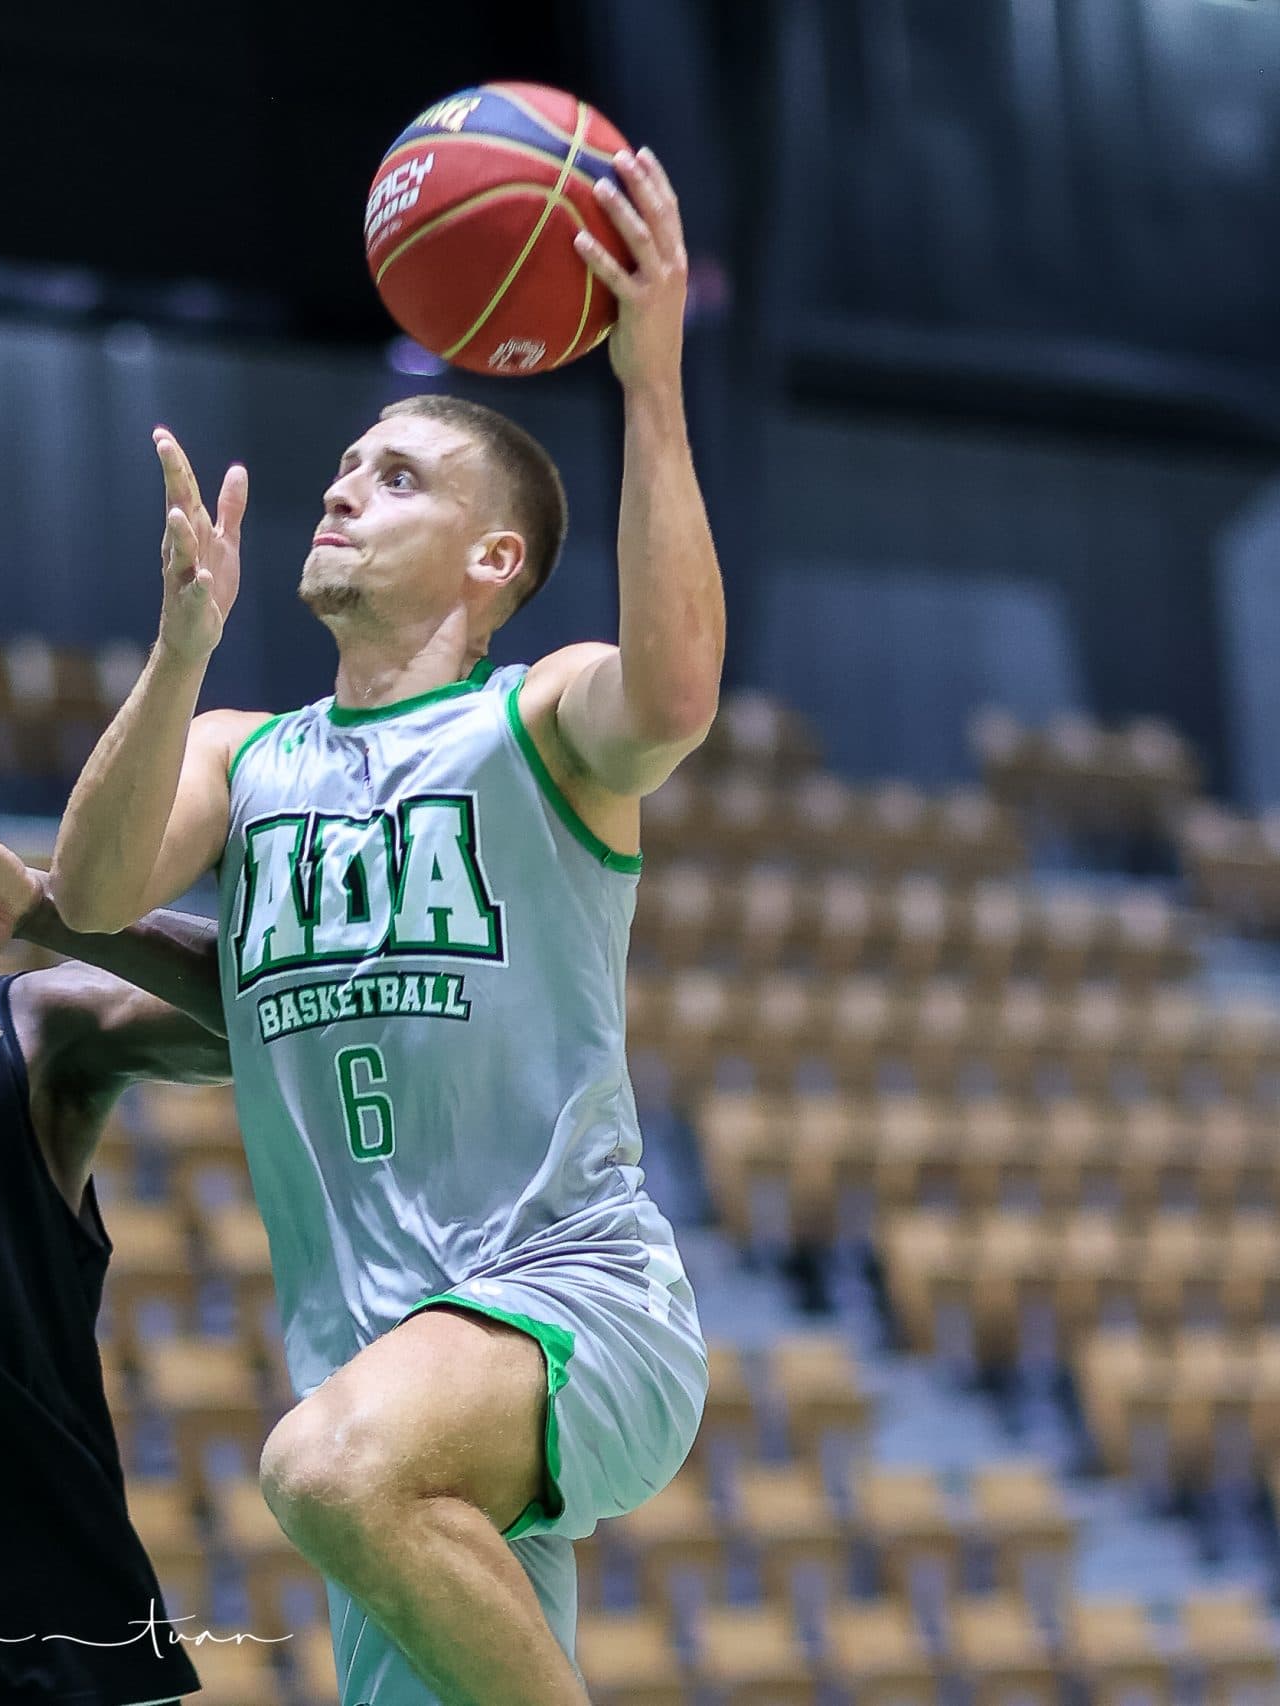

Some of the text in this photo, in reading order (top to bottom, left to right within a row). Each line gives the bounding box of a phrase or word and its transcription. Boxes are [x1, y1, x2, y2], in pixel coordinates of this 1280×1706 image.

[235, 791, 508, 997] ADA
[258, 972, 471, 1043] BASKETBALL
[334, 1043, 396, 1163] 6
